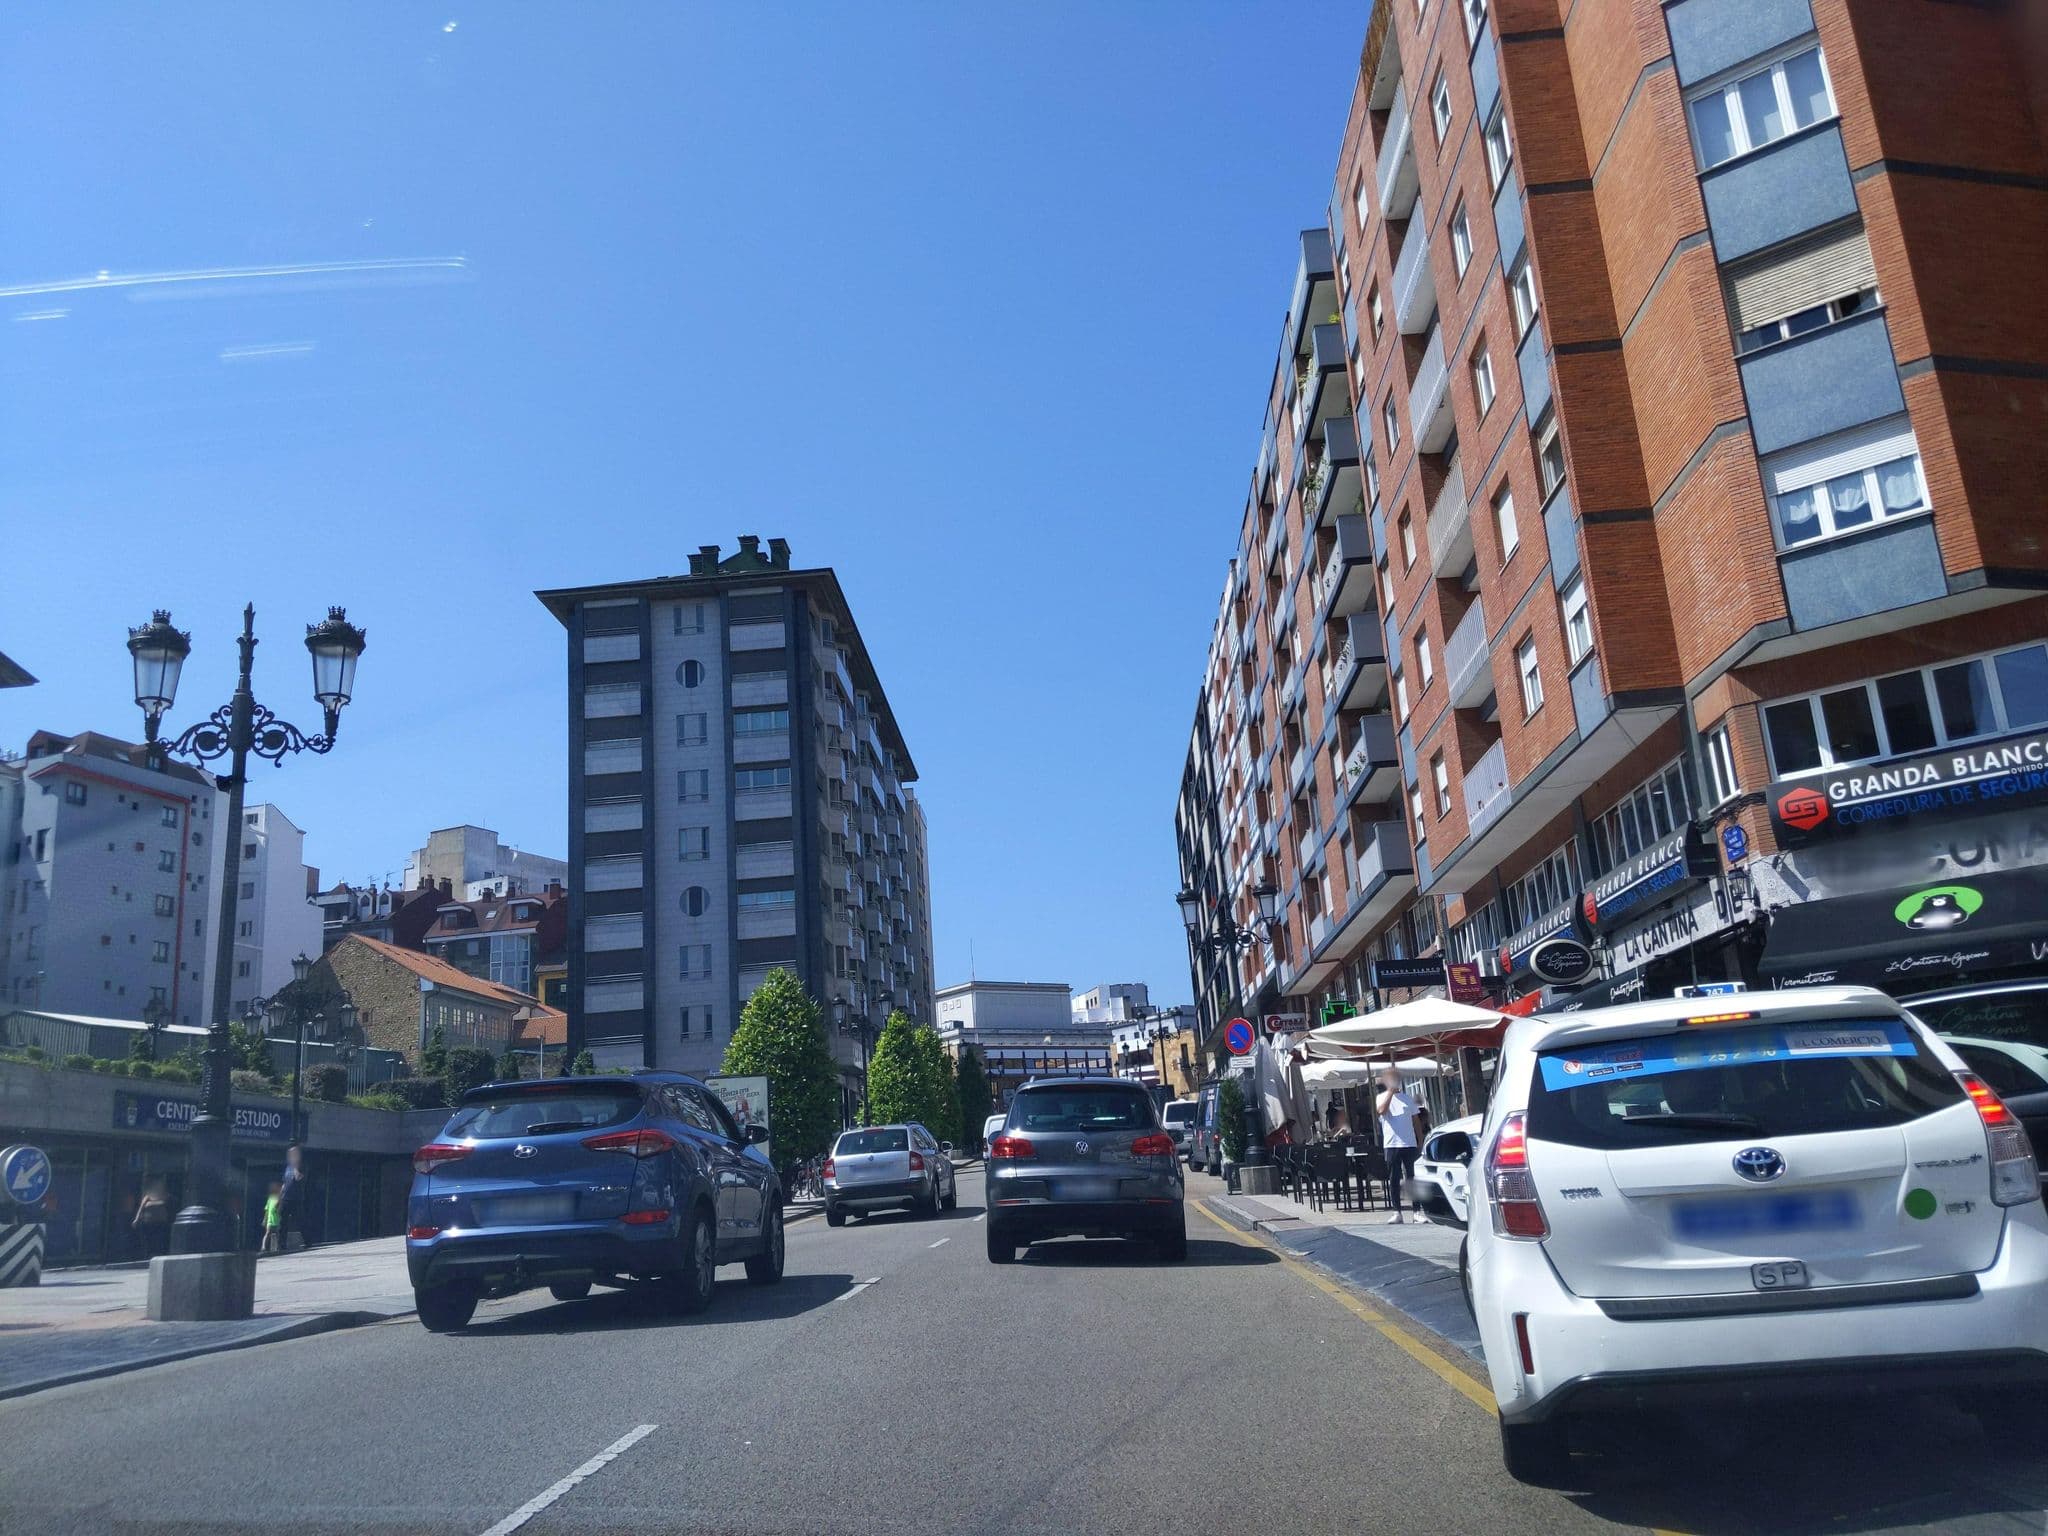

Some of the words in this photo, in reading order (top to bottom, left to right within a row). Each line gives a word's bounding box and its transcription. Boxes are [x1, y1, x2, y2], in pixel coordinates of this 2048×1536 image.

[1829, 764, 1941, 800] GRANDA
[1952, 742, 2048, 776] BLANC
[2011, 763, 2043, 774] OVIEDO
[1837, 790, 1947, 825] CORREDURIA
[1950, 786, 1974, 805] DE
[1595, 867, 1632, 901] GRANDA
[1638, 836, 1683, 875] BLANCO
[1509, 928, 1536, 955] GRANDA
[1539, 906, 1571, 936] BLANCO
[1624, 932, 1641, 962] LA
[1641, 907, 1699, 954] CANTINA
[1899, 955, 1943, 971] Cantina
[1809, 1035, 1881, 1047] COMERCIO
[157, 1101, 201, 1120] CENTR
[236, 1109, 281, 1129] ESTUDIO
[1758, 1262, 1799, 1286] SP
